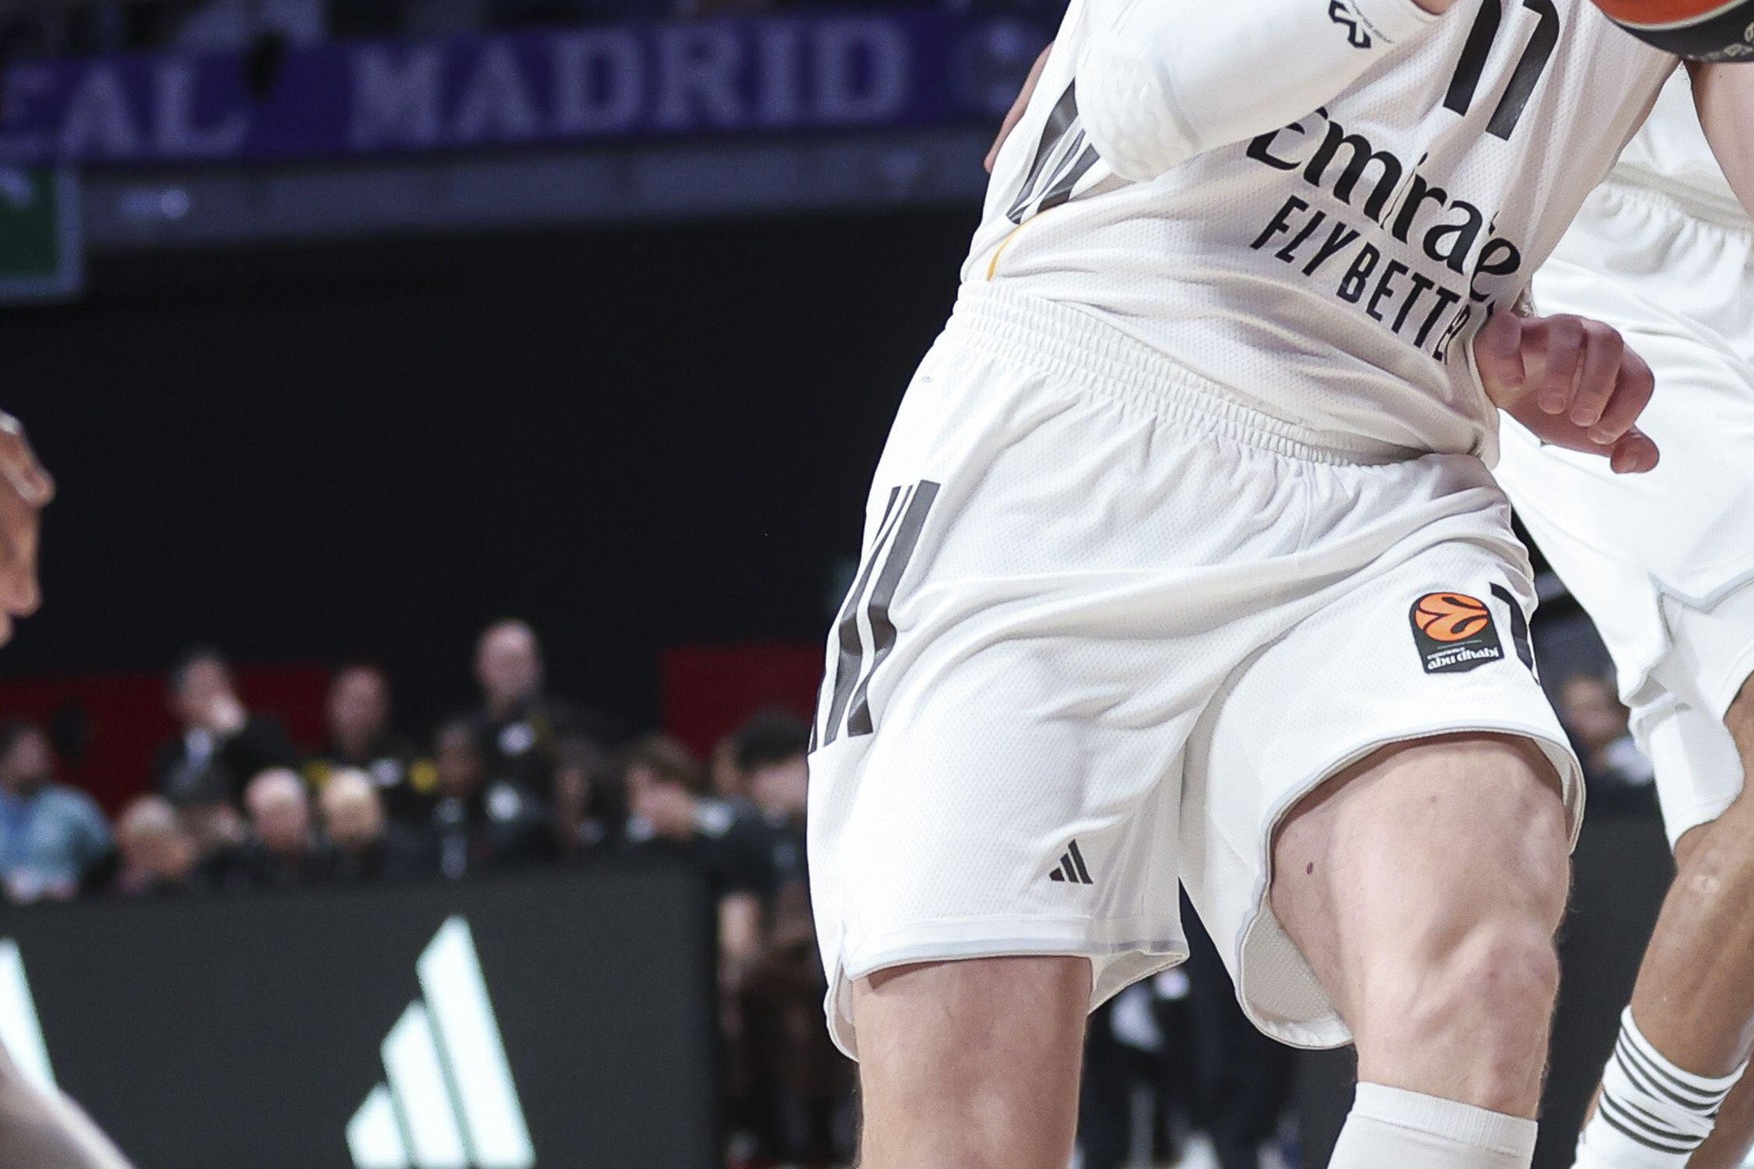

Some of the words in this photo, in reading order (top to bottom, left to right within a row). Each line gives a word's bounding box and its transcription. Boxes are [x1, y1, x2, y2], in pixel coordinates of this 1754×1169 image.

[352, 17, 912, 145] MADRID
[1250, 194, 1361, 277] FLY
[1427, 655, 1456, 670] abu
[1456, 647, 1500, 662] dhabi
